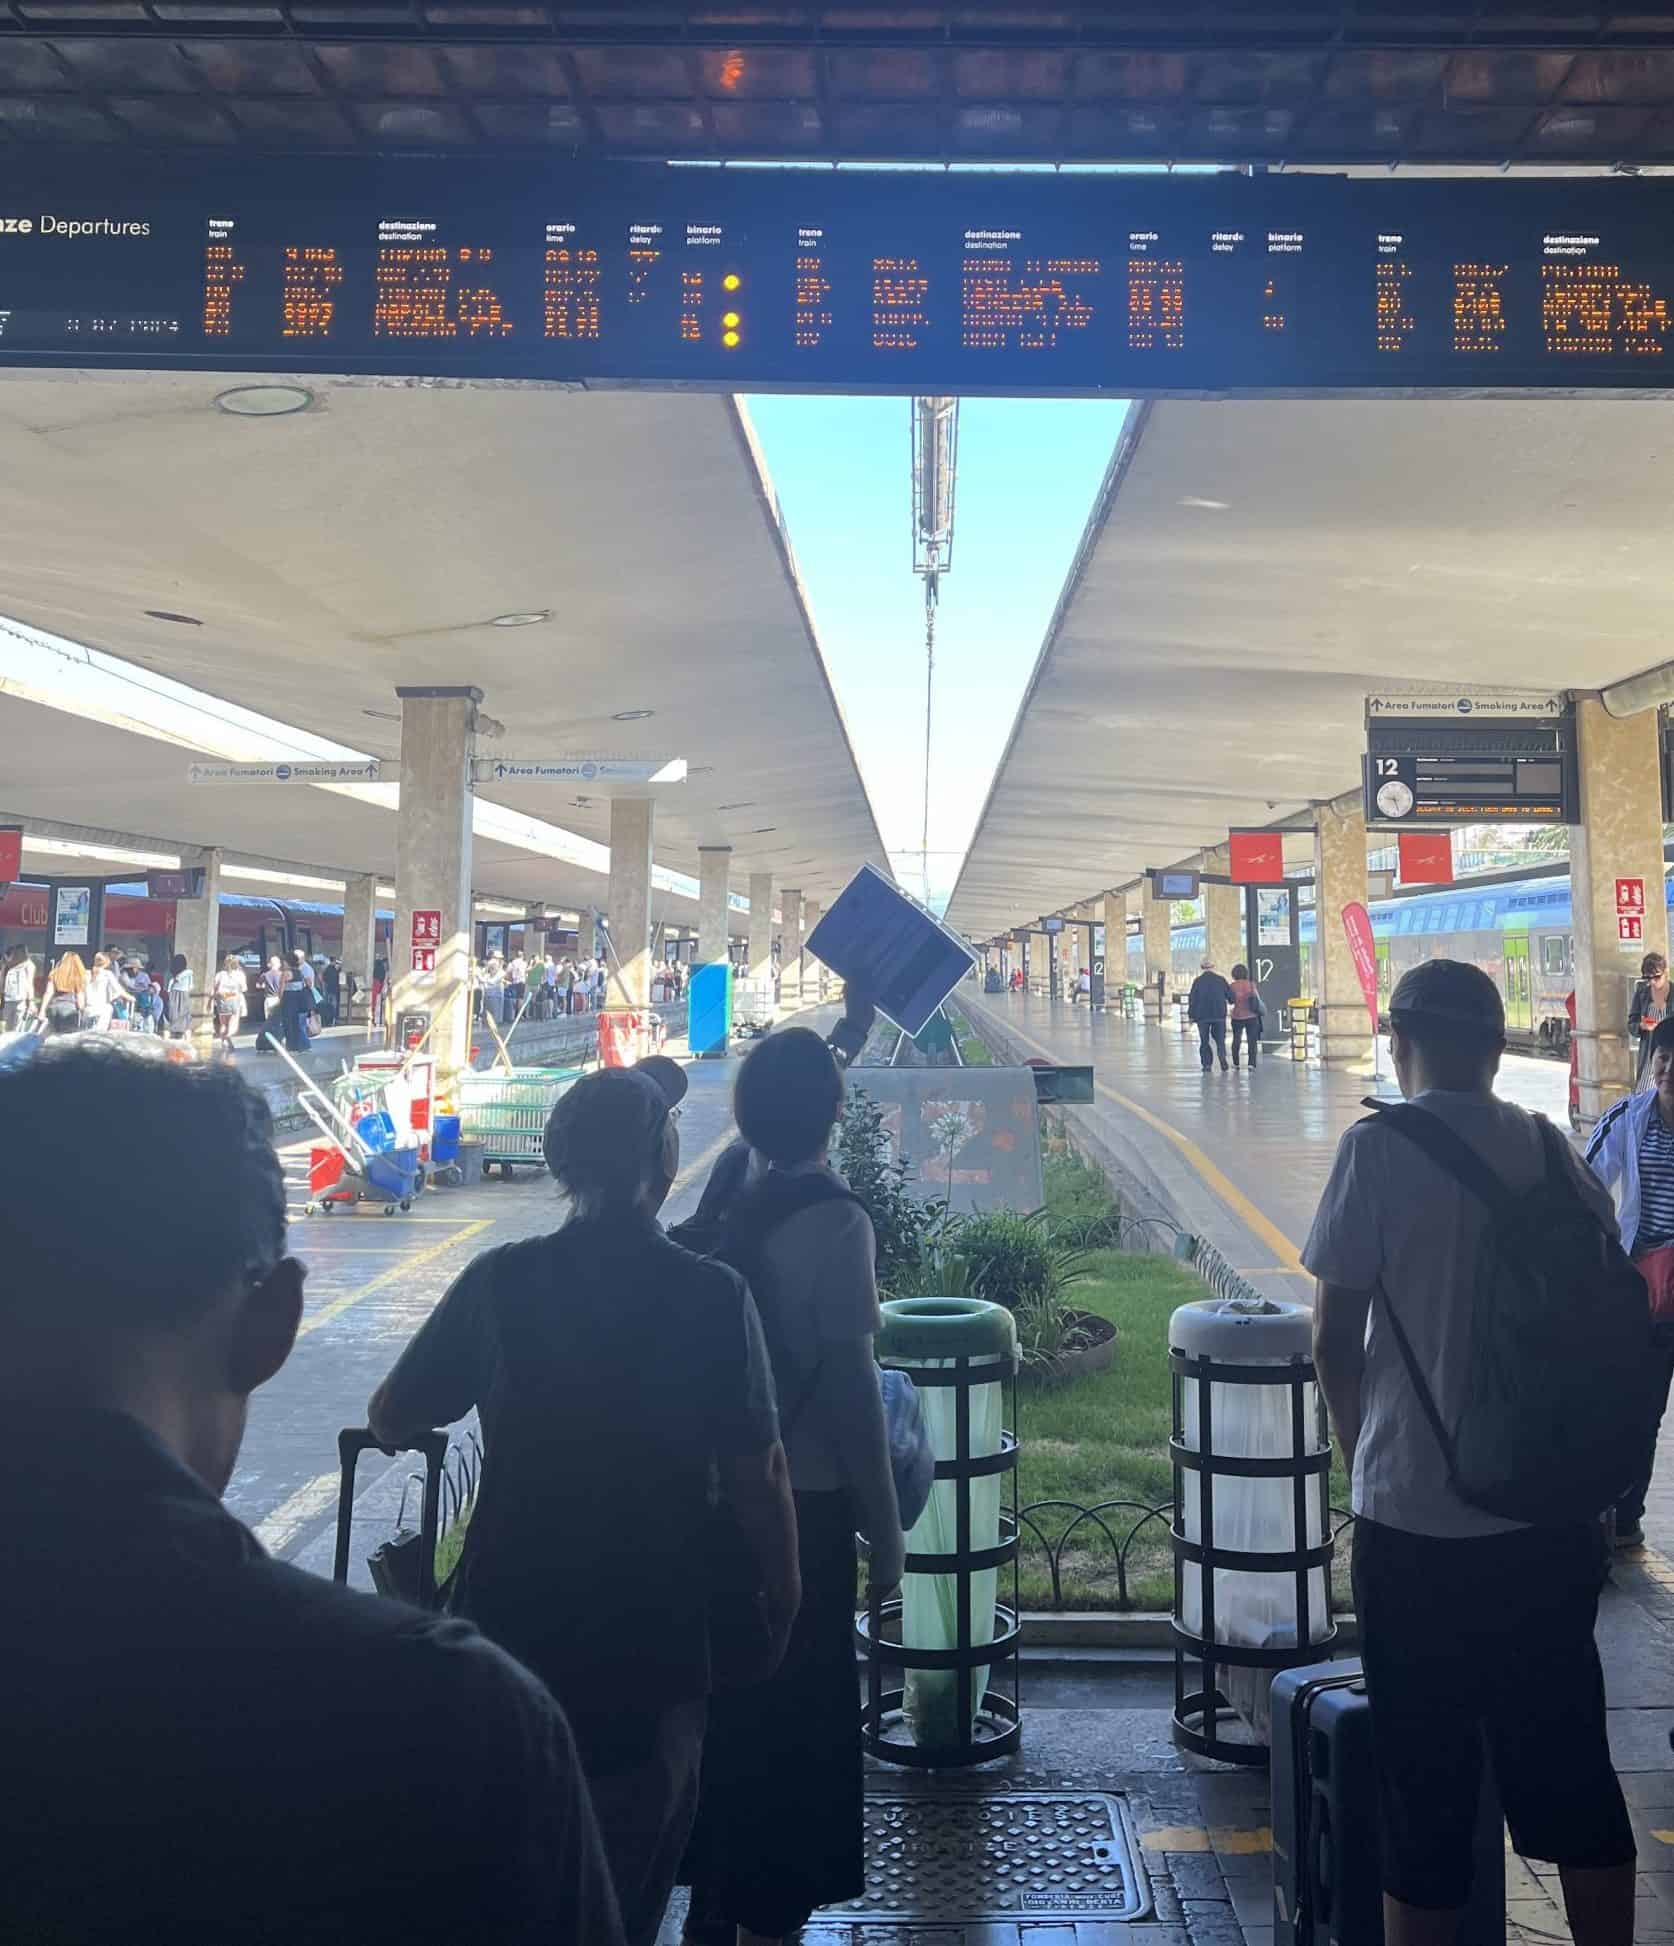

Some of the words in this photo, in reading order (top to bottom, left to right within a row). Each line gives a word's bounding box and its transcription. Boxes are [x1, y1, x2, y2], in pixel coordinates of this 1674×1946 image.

[40, 215, 150, 239] Departures
[208, 219, 235, 228] treno
[378, 220, 437, 231] destinazione
[545, 223, 576, 233] orario
[629, 224, 663, 234] ritardo
[686, 225, 722, 235] binario
[798, 229, 823, 237] treno
[208, 230, 228, 239] train
[378, 231, 423, 241] destination
[545, 234, 564, 243] time
[964, 229, 1022, 240] destinazione
[1129, 231, 1159, 241] orario
[1211, 231, 1244, 241] ritardo
[1268, 232, 1304, 242] binario
[1377, 234, 1403, 243] treno
[629, 235, 652, 245] delay
[686, 235, 721, 245] platform
[798, 239, 817, 247] train
[964, 240, 1008, 249] destination
[1542, 235, 1600, 245] destinazione
[1129, 242, 1148, 251] time
[1211, 242, 1234, 252] delay
[1268, 242, 1303, 253] platform
[1378, 245, 1397, 253] train
[1543, 246, 1587, 256] destination
[1384, 701, 1409, 710] Area
[1410, 701, 1455, 710] Fumatori
[1474, 701, 1518, 712] Smoking
[1519, 701, 1545, 710] Area
[230, 766, 274, 777] Fumatori
[293, 767, 337, 777] Smoking
[338, 767, 364, 776] Area
[508, 766, 534, 775] Area
[535, 765, 580, 775] Fumatori
[1375, 758, 1399, 776] 12
[21, 903, 48, 925] Club
[1255, 958, 1274, 983] 12
